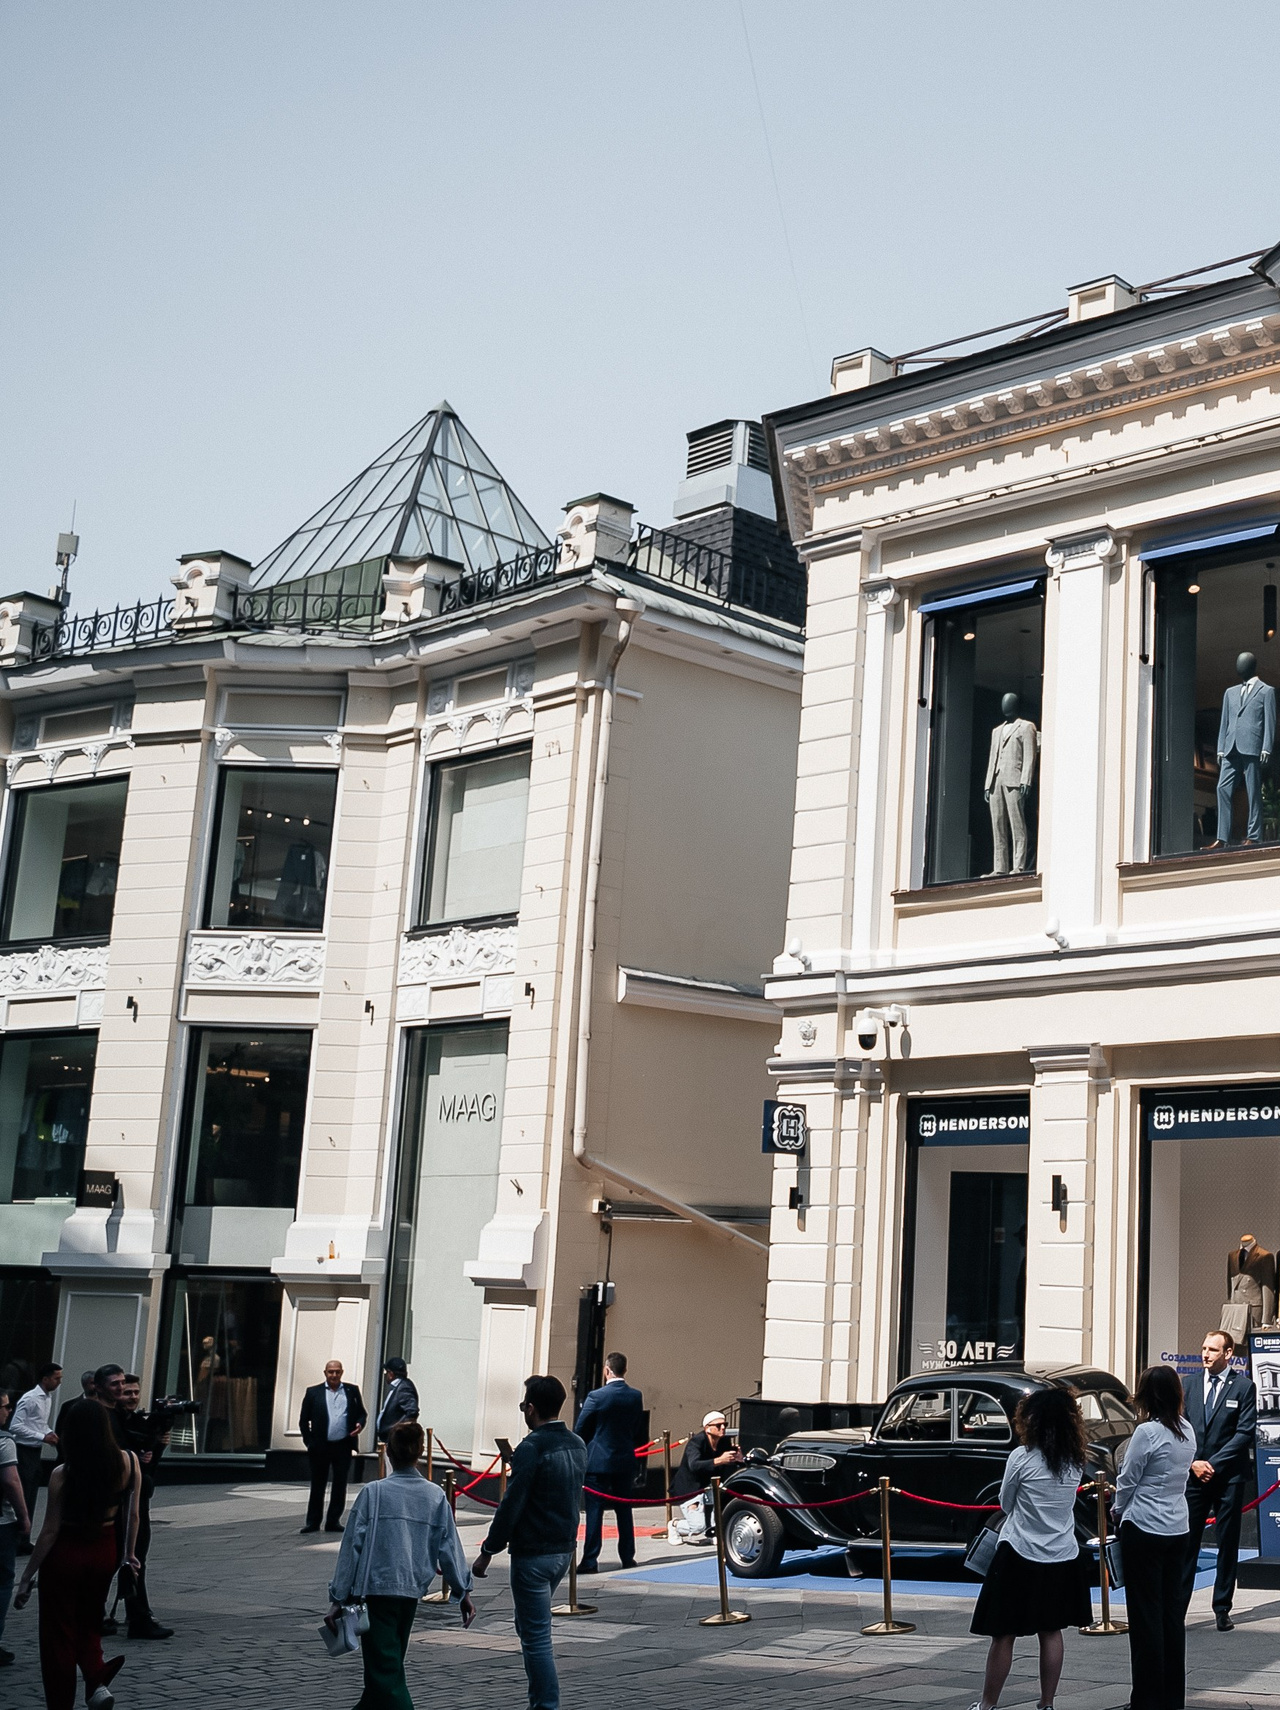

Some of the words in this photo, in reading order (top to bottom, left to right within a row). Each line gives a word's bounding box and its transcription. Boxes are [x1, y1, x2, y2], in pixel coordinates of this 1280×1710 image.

[439, 1093, 497, 1122] MAAG
[938, 1116, 1029, 1131] HENDERSON
[86, 1184, 112, 1195] MAAG
[936, 1340, 957, 1359] 30
[961, 1340, 996, 1360] ЛЕТ
[1160, 1352, 1203, 1363] Создава
[922, 1360, 975, 1369] МУЖСКО
